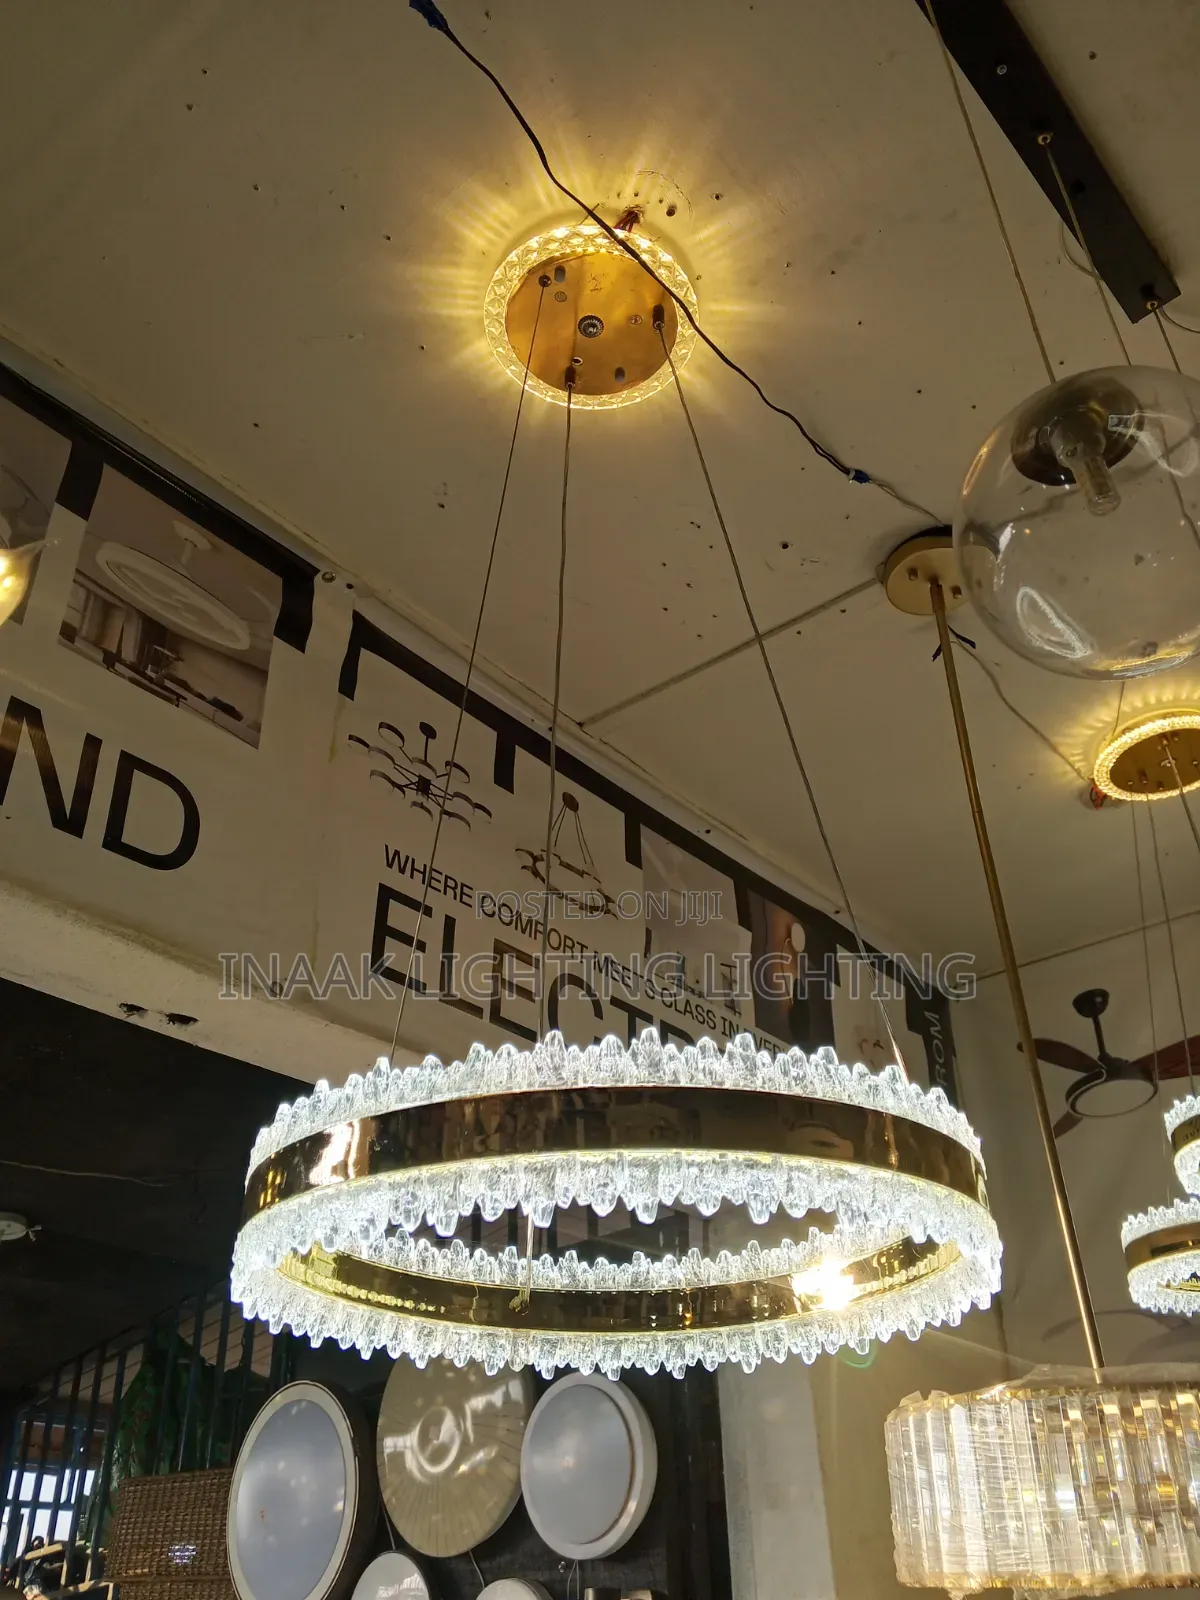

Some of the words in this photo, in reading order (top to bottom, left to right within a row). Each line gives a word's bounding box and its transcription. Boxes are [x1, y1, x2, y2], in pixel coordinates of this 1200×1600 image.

[384, 843, 474, 909] WHERE
[481, 894, 589, 965] COMFORT
[661, 987, 717, 1031] CLASS
[720, 1016, 740, 1039] IN
